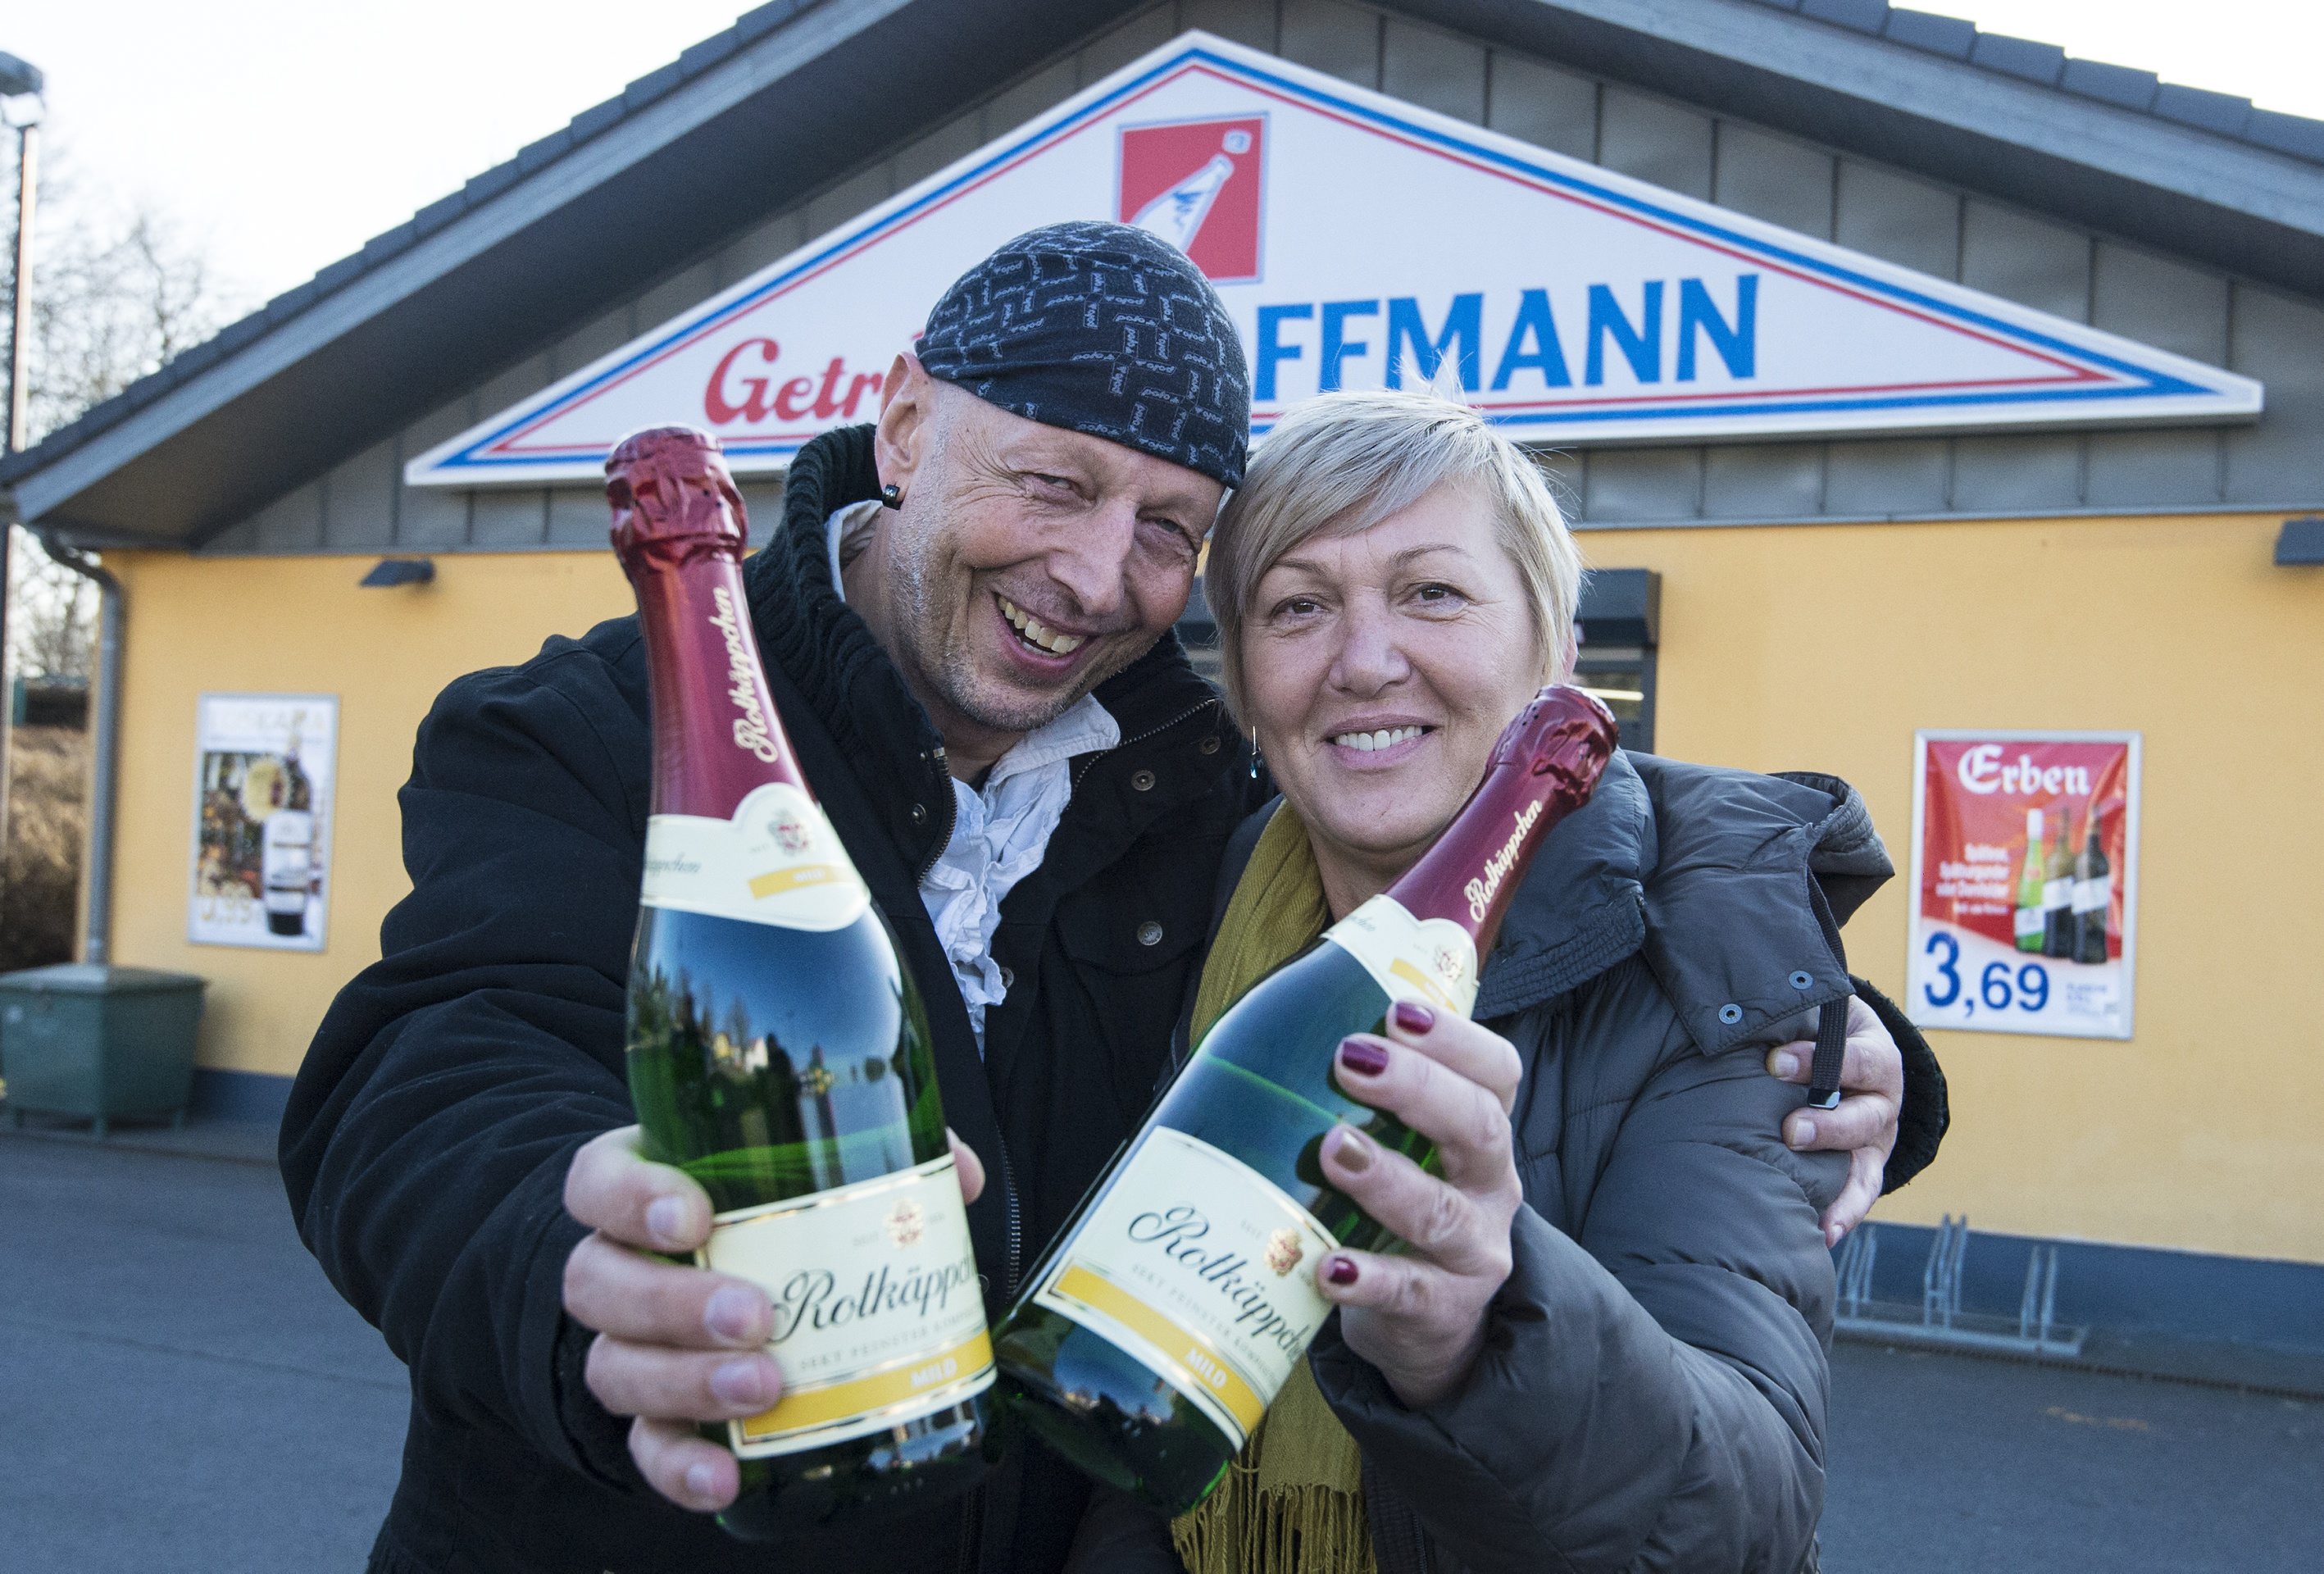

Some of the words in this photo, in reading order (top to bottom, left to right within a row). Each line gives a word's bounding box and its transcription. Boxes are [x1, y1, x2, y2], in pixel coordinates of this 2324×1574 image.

[703, 337, 884, 425] Getr
[1254, 275, 1759, 402] FFMANN
[1958, 744, 2091, 796] Erben
[1463, 798, 1544, 924] Rotkäppchen
[1924, 930, 2049, 1020] 3,69
[1128, 1204, 1310, 1366] Rotkäppch
[910, 1357, 957, 1390] MILD
[1185, 1347, 1228, 1390] MILD
